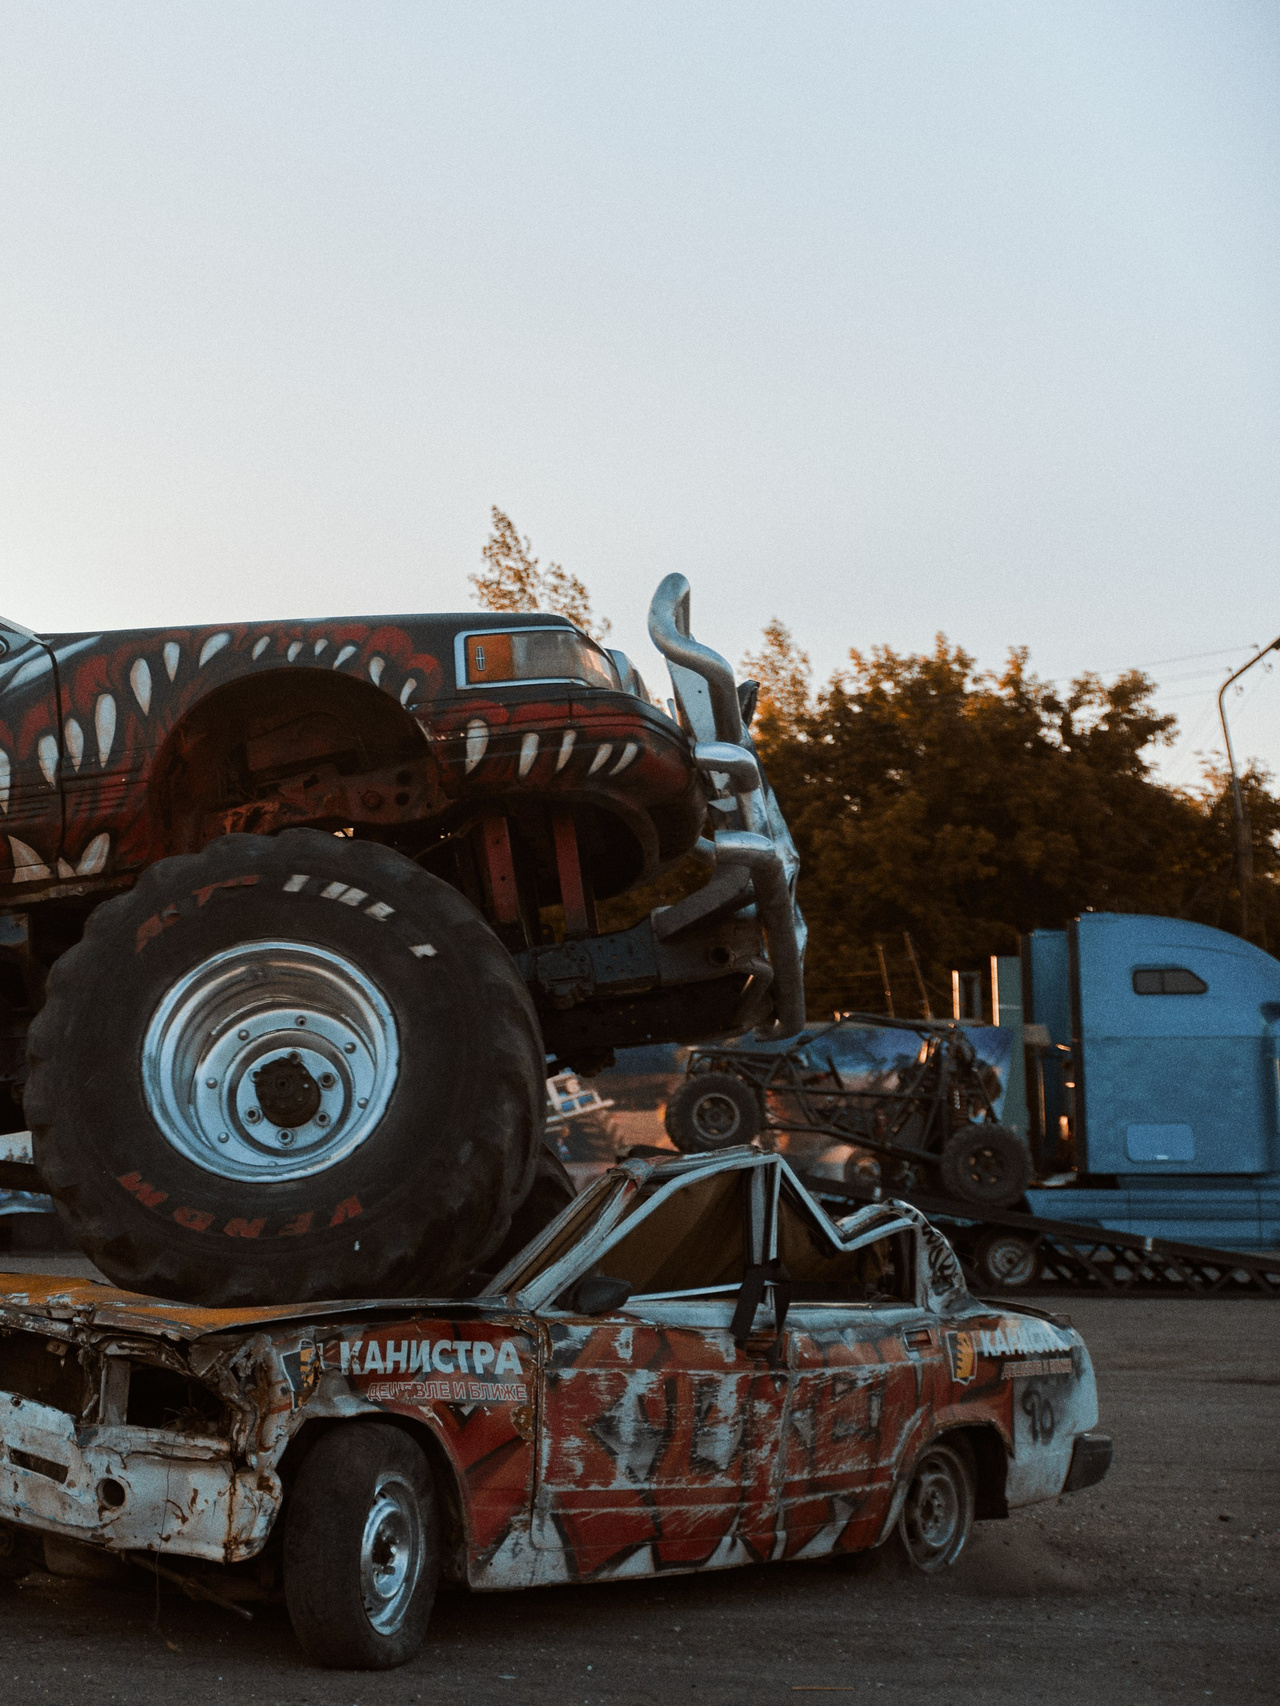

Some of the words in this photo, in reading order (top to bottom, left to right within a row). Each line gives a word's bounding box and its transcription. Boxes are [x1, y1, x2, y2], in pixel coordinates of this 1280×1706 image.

[340, 1339, 523, 1375] КАНИСТРА
[453, 1381, 467, 1400] И
[469, 1382, 527, 1401] БЛИЖЕ
